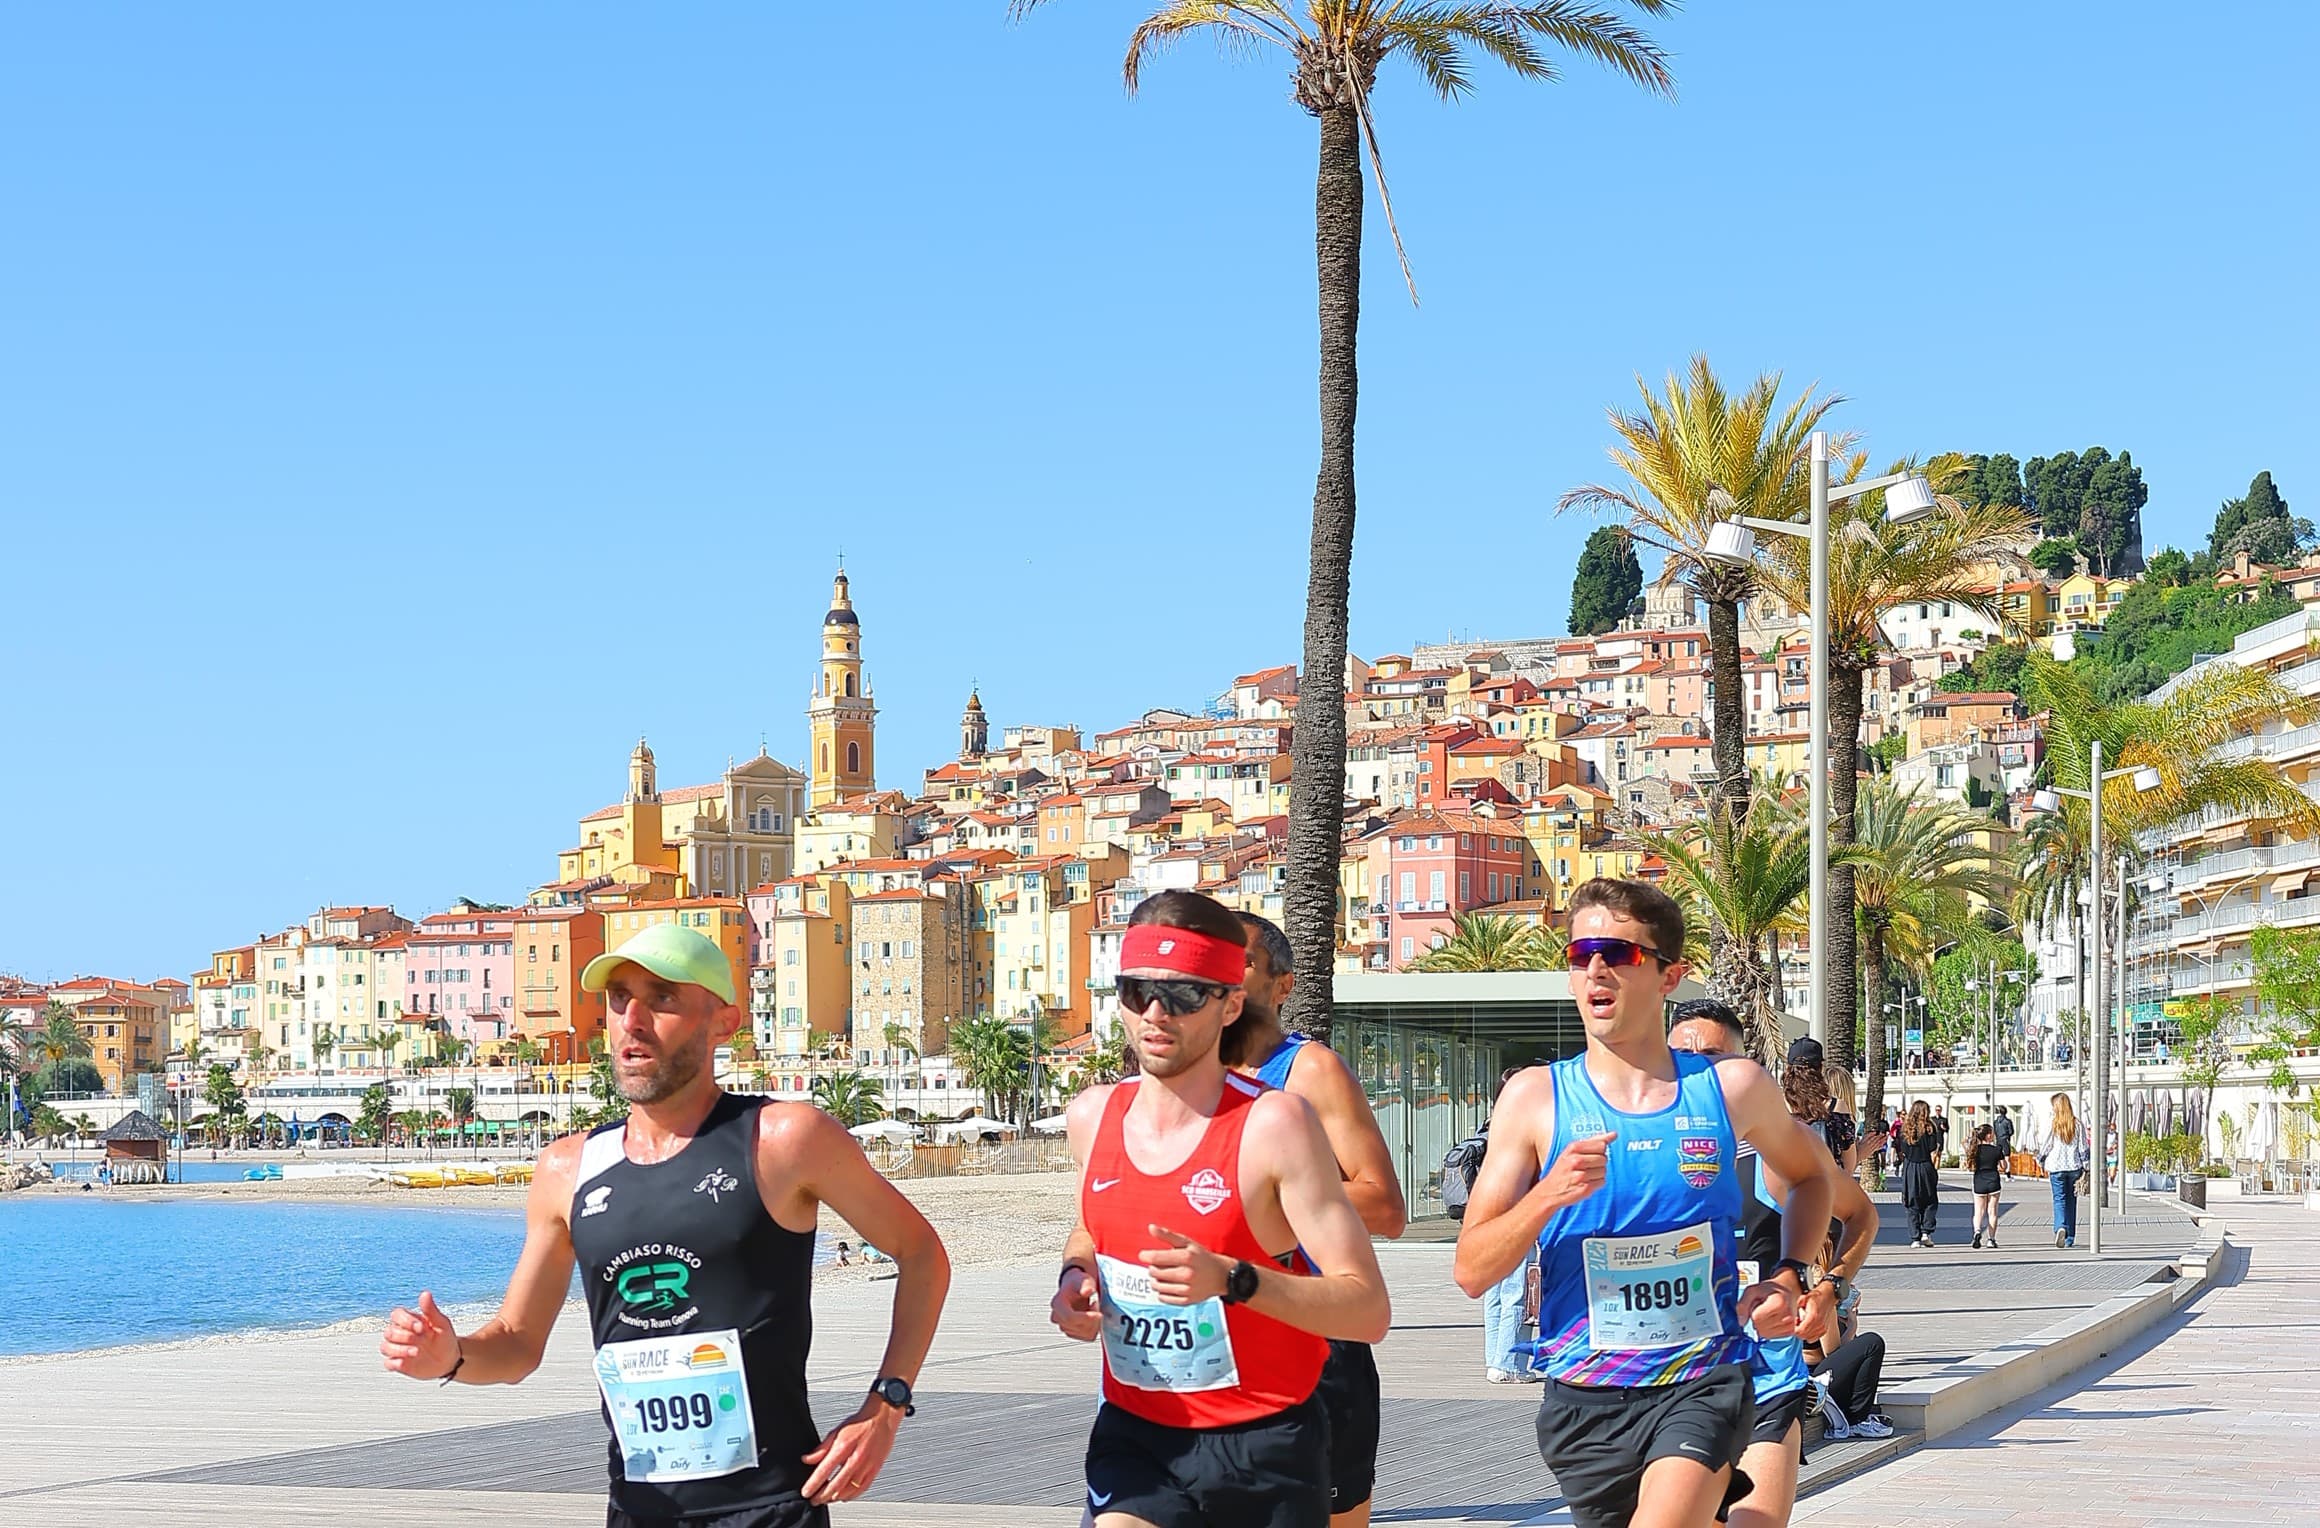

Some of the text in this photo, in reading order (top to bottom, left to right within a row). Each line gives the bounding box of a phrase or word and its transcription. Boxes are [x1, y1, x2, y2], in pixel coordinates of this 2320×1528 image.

[1627, 1139, 1662, 1151] NOLT
[1683, 1140, 1716, 1150] NICE
[603, 1243, 702, 1282] CAMBIASO RISSO
[1630, 1243, 1661, 1260] RACE
[617, 1262, 690, 1304] CR
[1619, 1277, 1689, 1312] 1899
[618, 1306, 699, 1330] Running Team Genova
[1120, 1314, 1194, 1351] 2225
[638, 1348, 670, 1368] RACE
[635, 1393, 713, 1434] 1999
